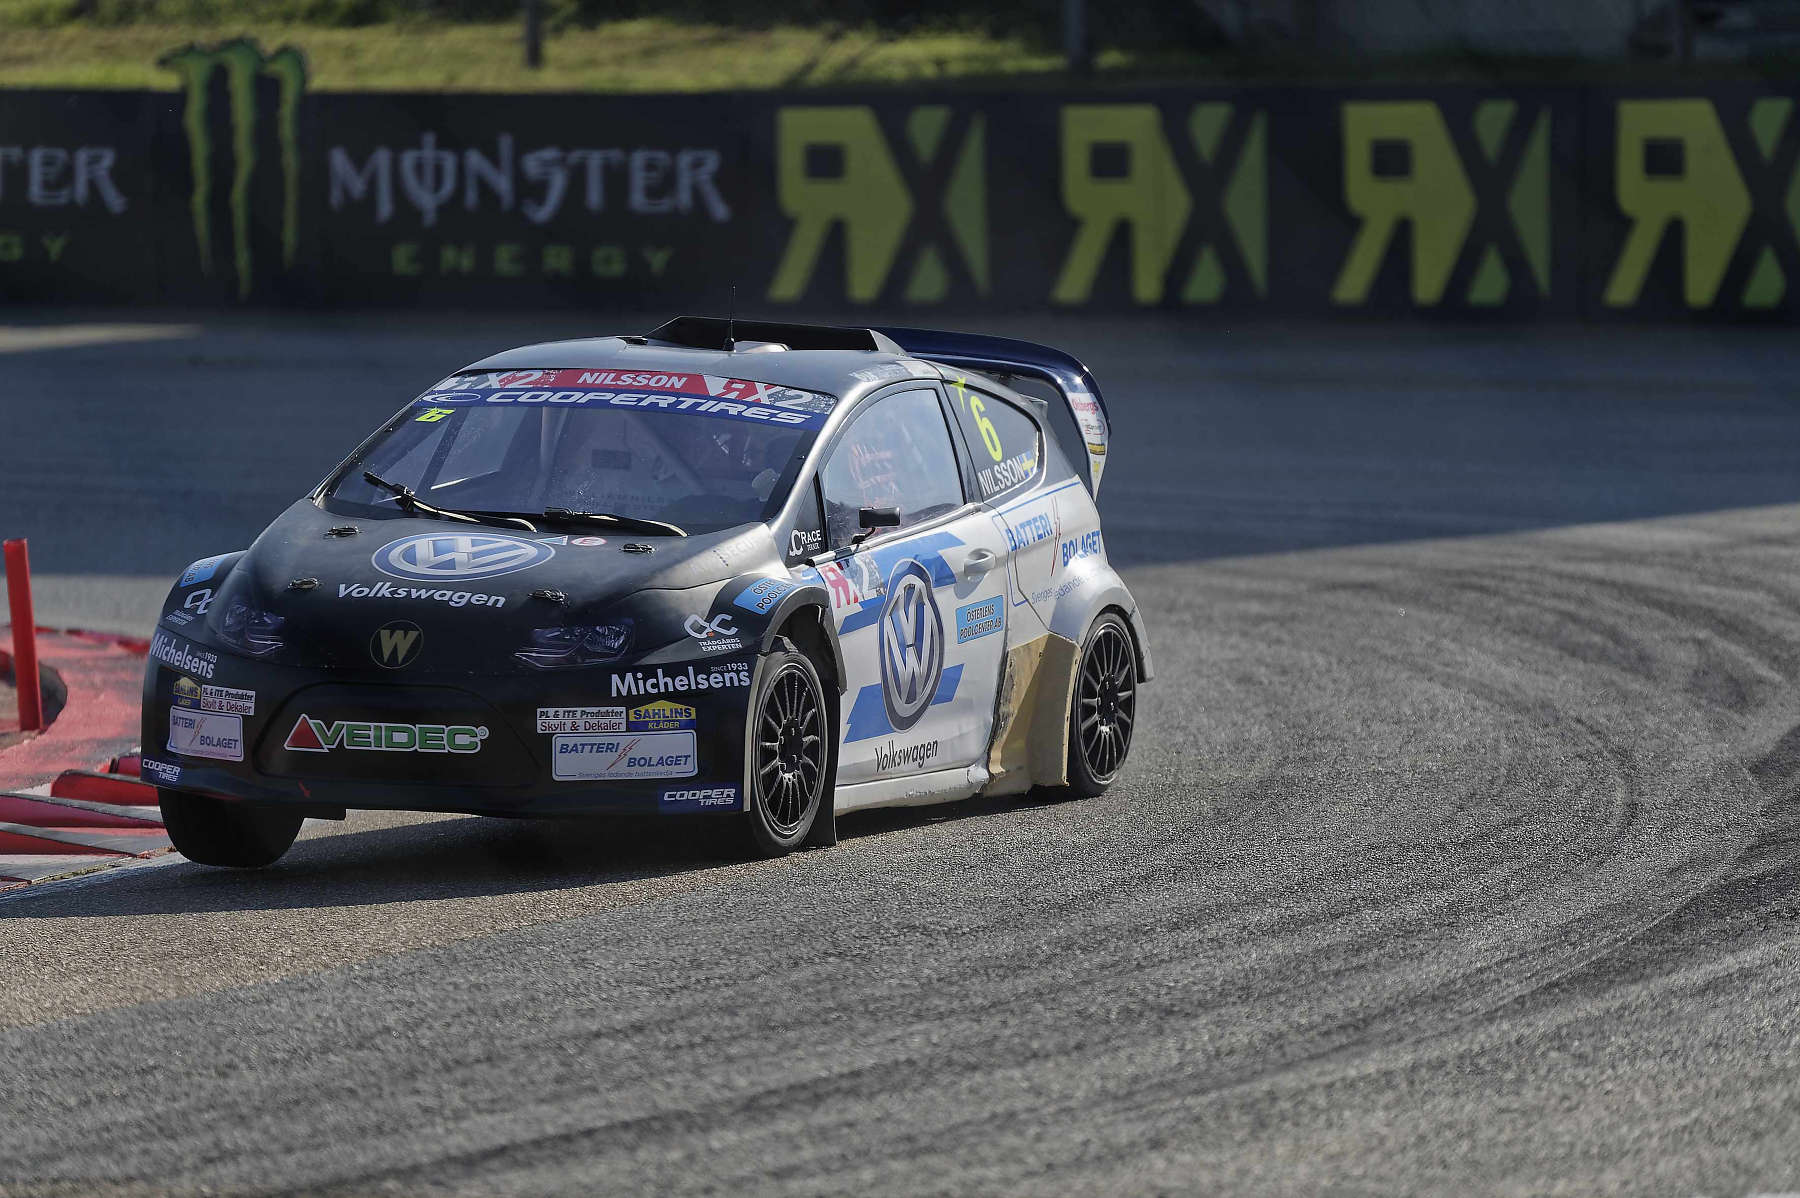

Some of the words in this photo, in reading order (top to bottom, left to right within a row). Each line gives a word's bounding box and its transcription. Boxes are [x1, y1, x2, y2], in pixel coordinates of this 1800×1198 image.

[329, 131, 731, 226] MONSTER
[391, 243, 674, 277] ENERGY
[577, 372, 688, 389] NILSSON
[970, 395, 1003, 462] 6
[977, 456, 1026, 496] NILSSON
[337, 582, 506, 608] Volkswagen
[150, 632, 214, 679] Michelsens
[727, 663, 748, 671] 1933
[611, 666, 750, 697] Michelsens
[580, 709, 624, 718] Produkter
[634, 708, 692, 720] SAHLINS
[540, 721, 566, 732] Skylt
[570, 721, 580, 731] &
[584, 720, 622, 731] Dekaler
[200, 735, 239, 749] BOLAGET
[312, 721, 482, 752] VEIDEC
[559, 742, 620, 754] BATTERI
[875, 739, 938, 773] Volkswagen
[142, 759, 181, 776] COOPER
[626, 755, 691, 767] BOLAGET
[158, 771, 178, 782] TIRES
[664, 789, 736, 800] COOPER
[698, 798, 735, 806] TIRES
